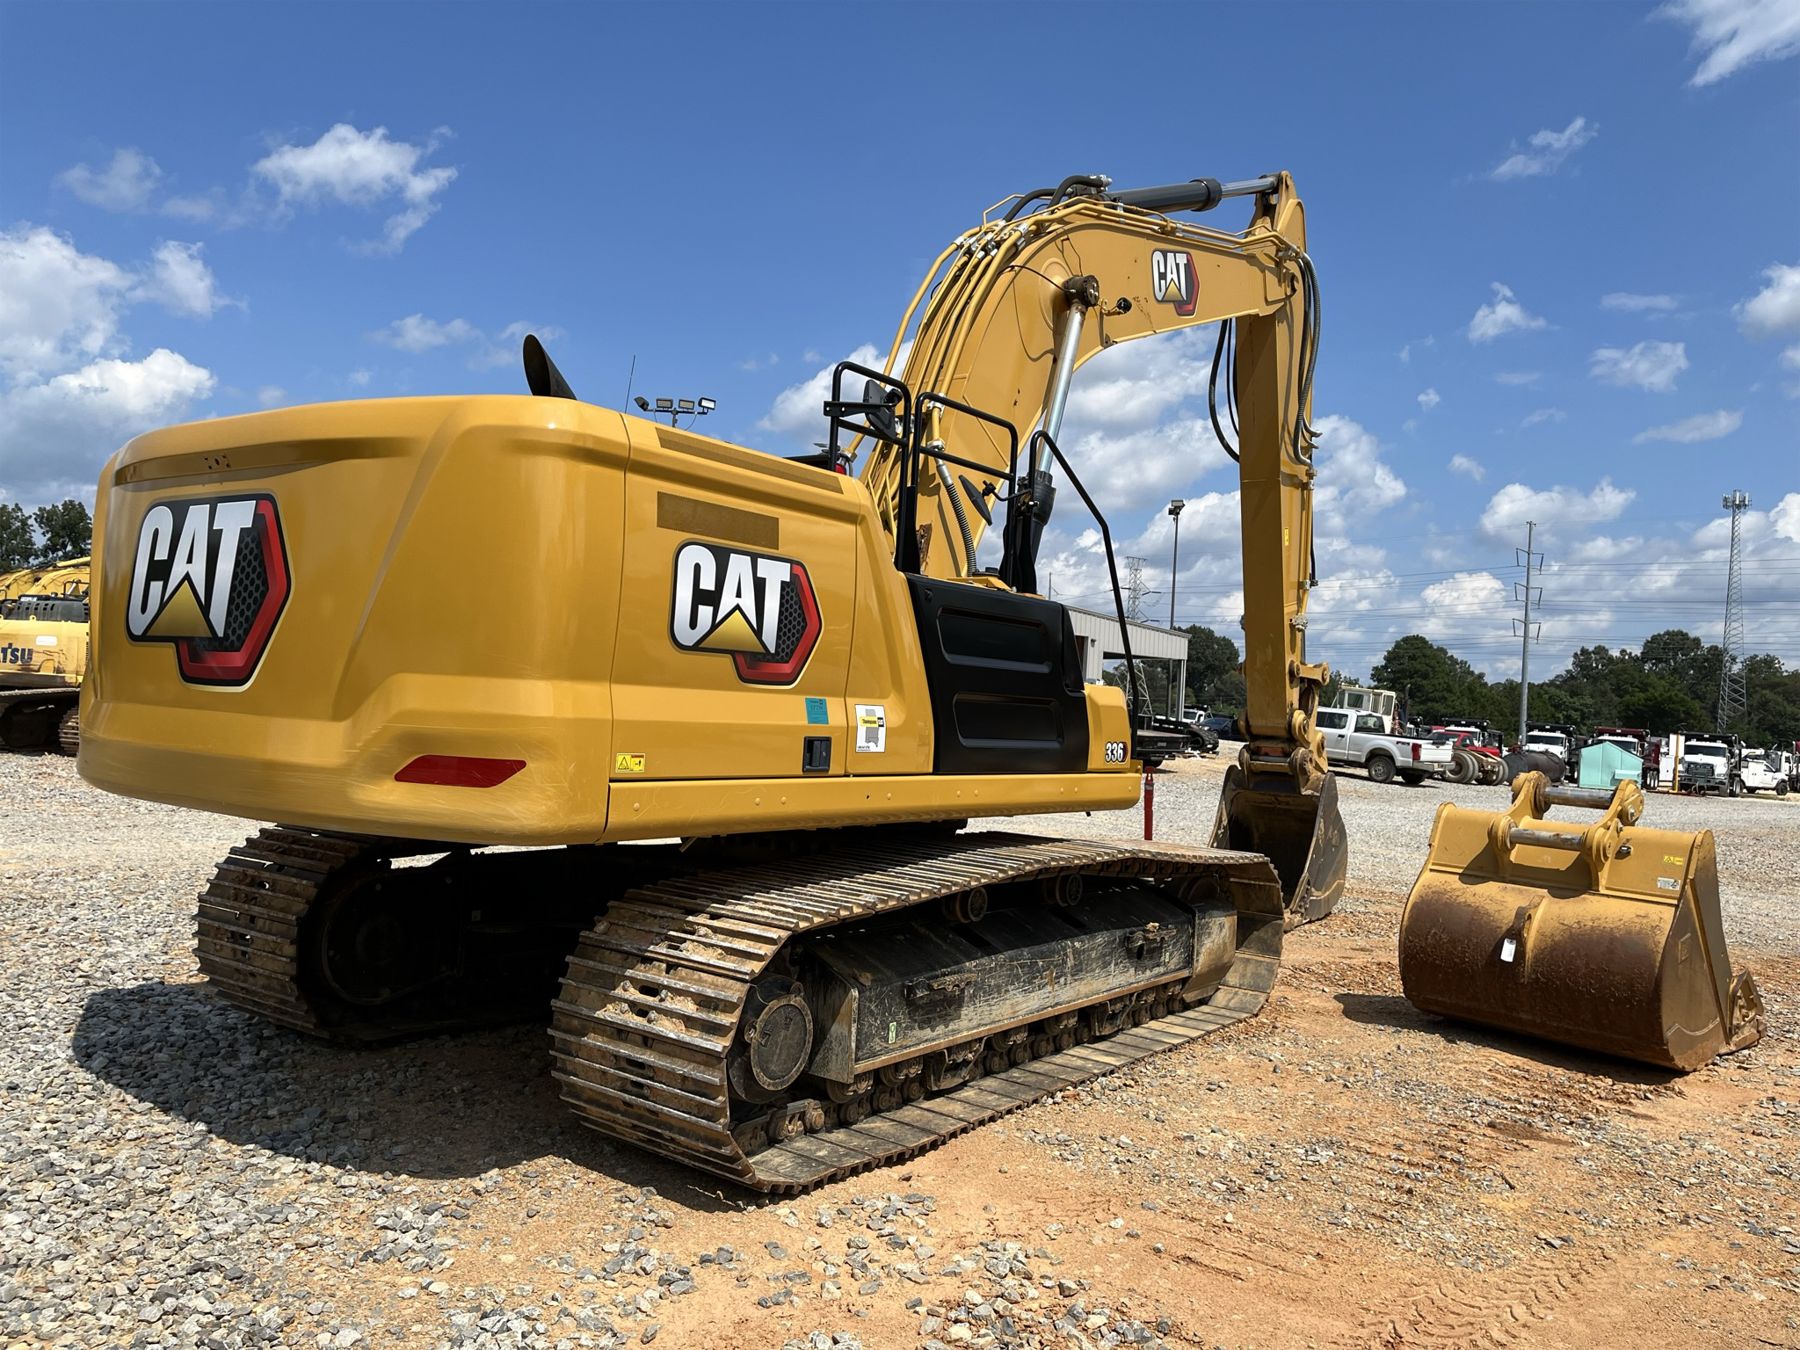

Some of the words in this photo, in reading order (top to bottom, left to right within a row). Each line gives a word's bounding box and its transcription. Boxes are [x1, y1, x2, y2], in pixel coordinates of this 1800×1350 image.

[1152, 250, 1188, 301] CAT
[128, 500, 256, 638] CAT
[673, 544, 791, 654] CAT
[0, 643, 33, 664] TSU
[1105, 742, 1124, 762] 336
